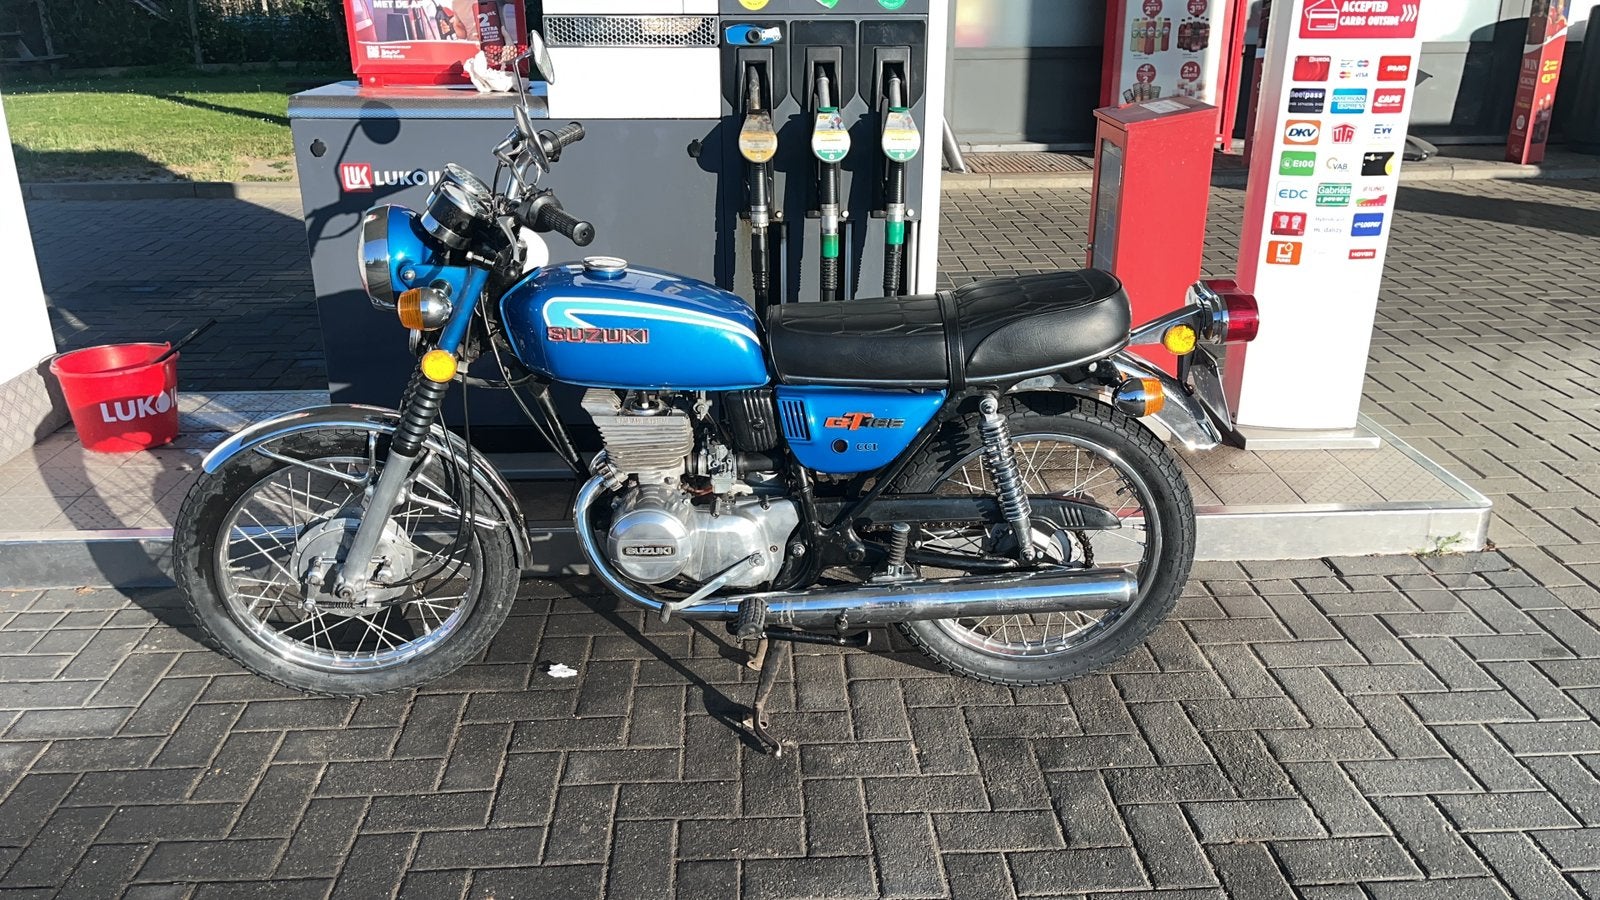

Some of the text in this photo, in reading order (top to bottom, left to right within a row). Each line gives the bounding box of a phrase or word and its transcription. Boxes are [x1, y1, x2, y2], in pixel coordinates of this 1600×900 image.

[373, 0, 393, 8] MET
[395, 0, 408, 8] DE
[1341, 1, 1389, 13] ACCEPTED
[1340, 16, 1400, 26] CARDS OUTSIDE
[1288, 128, 1316, 137] DKV
[1333, 128, 1354, 142] UTA
[343, 165, 372, 189] LUK
[1279, 189, 1308, 199] EDC
[547, 326, 649, 344] SUZUKI
[625, 546, 672, 555] SUZUKI
